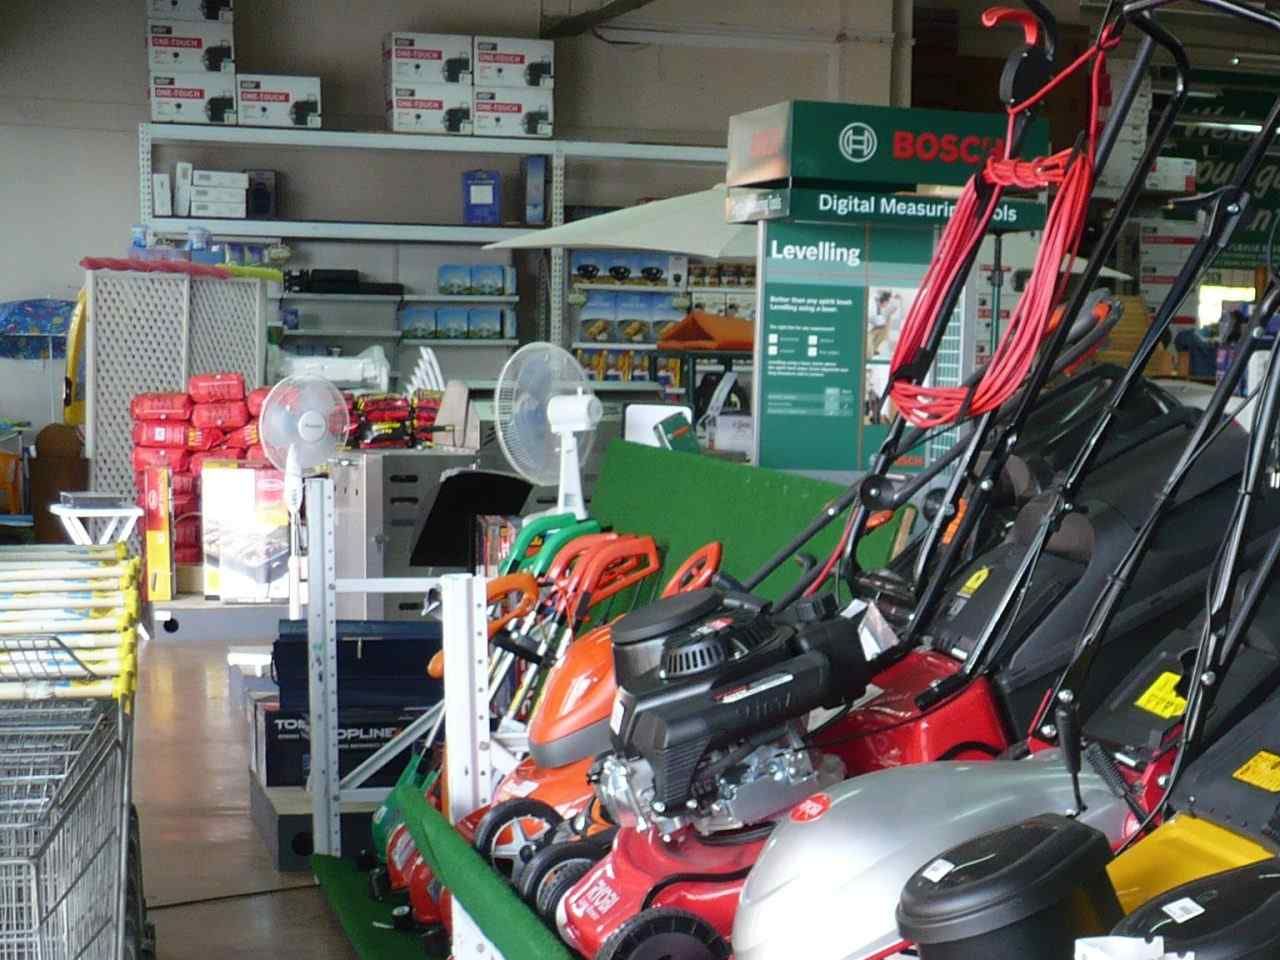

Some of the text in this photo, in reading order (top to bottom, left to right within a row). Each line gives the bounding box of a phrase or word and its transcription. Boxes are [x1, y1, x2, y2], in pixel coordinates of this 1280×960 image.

[818, 193, 875, 216] Digital
[880, 195, 958, 217] Measuri
[771, 240, 861, 267] Levelling
[337, 727, 397, 740] OPLINE
